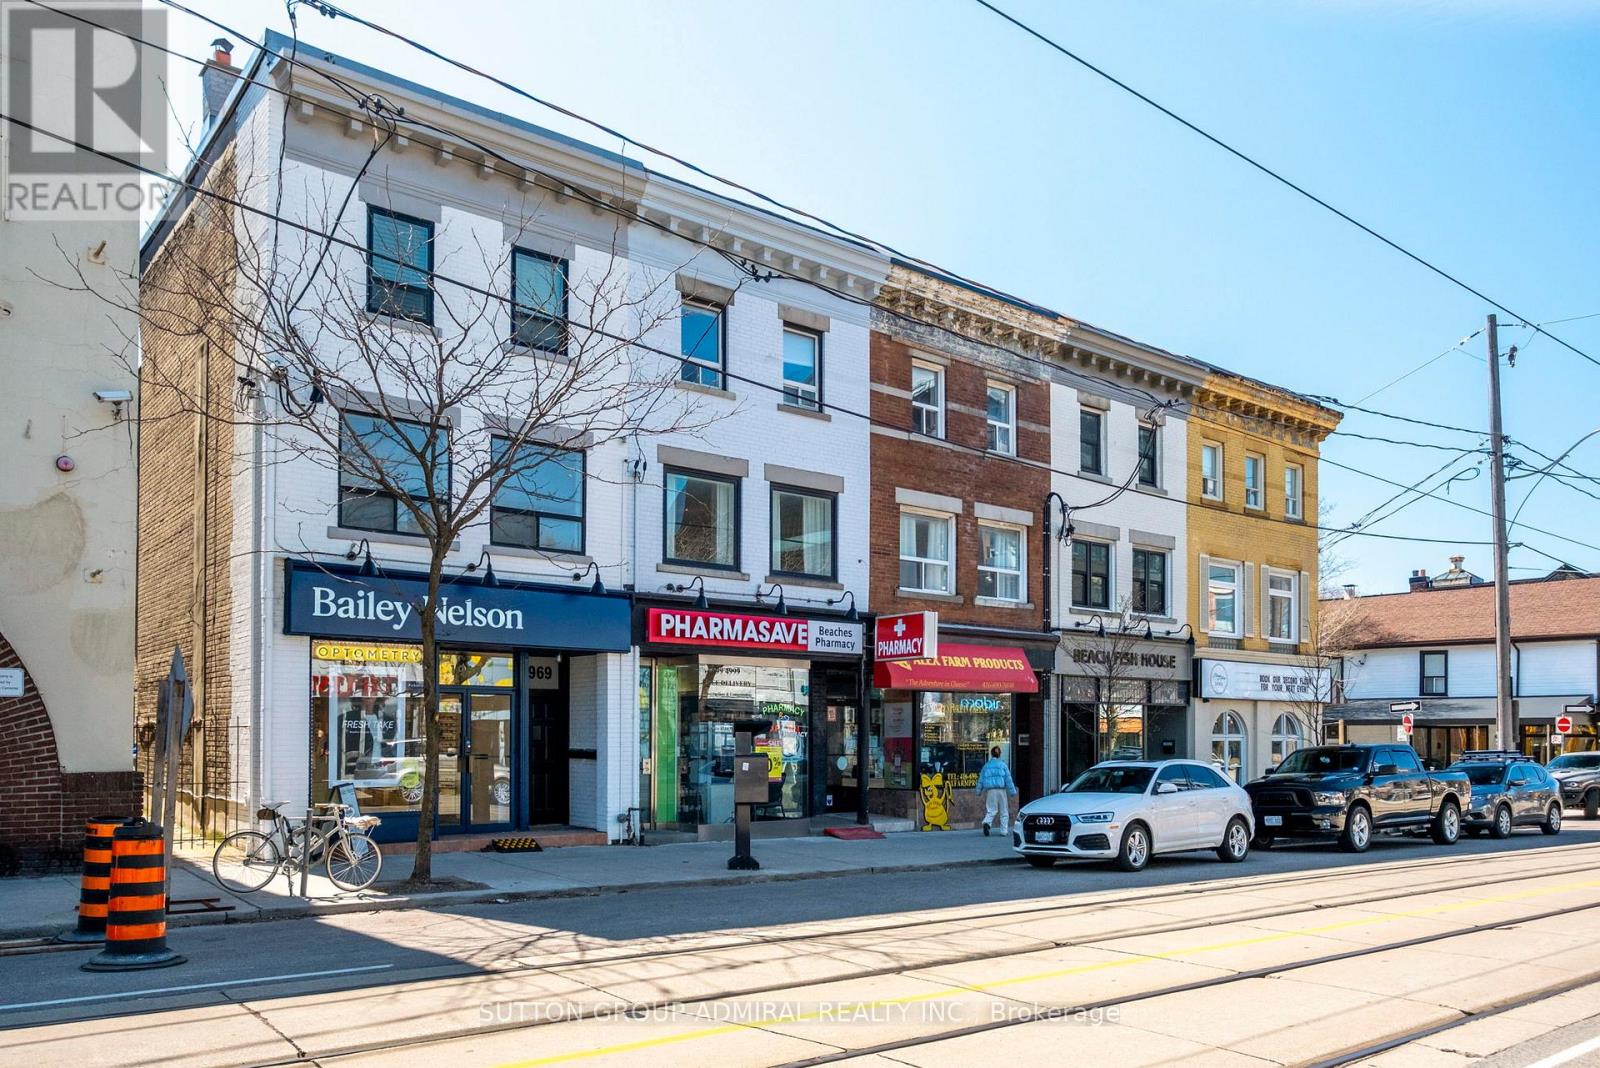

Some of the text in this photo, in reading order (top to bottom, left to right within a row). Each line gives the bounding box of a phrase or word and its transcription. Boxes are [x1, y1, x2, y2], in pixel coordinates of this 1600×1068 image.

[312, 586, 414, 630] Bailey
[660, 613, 808, 645] PHARMASAVE
[819, 626, 853, 638] Beaches
[815, 637, 856, 651] Pharmacy
[878, 637, 923, 656] PHARMACY
[318, 647, 420, 661] OPTOMETRY
[1141, 653, 1176, 669] HOUSE
[943, 655, 971, 668] FARM
[974, 657, 1025, 671] PRODUCTS
[528, 665, 553, 680] 969
[762, 703, 805, 717] PHARMACY
[342, 720, 371, 729] FRESH
